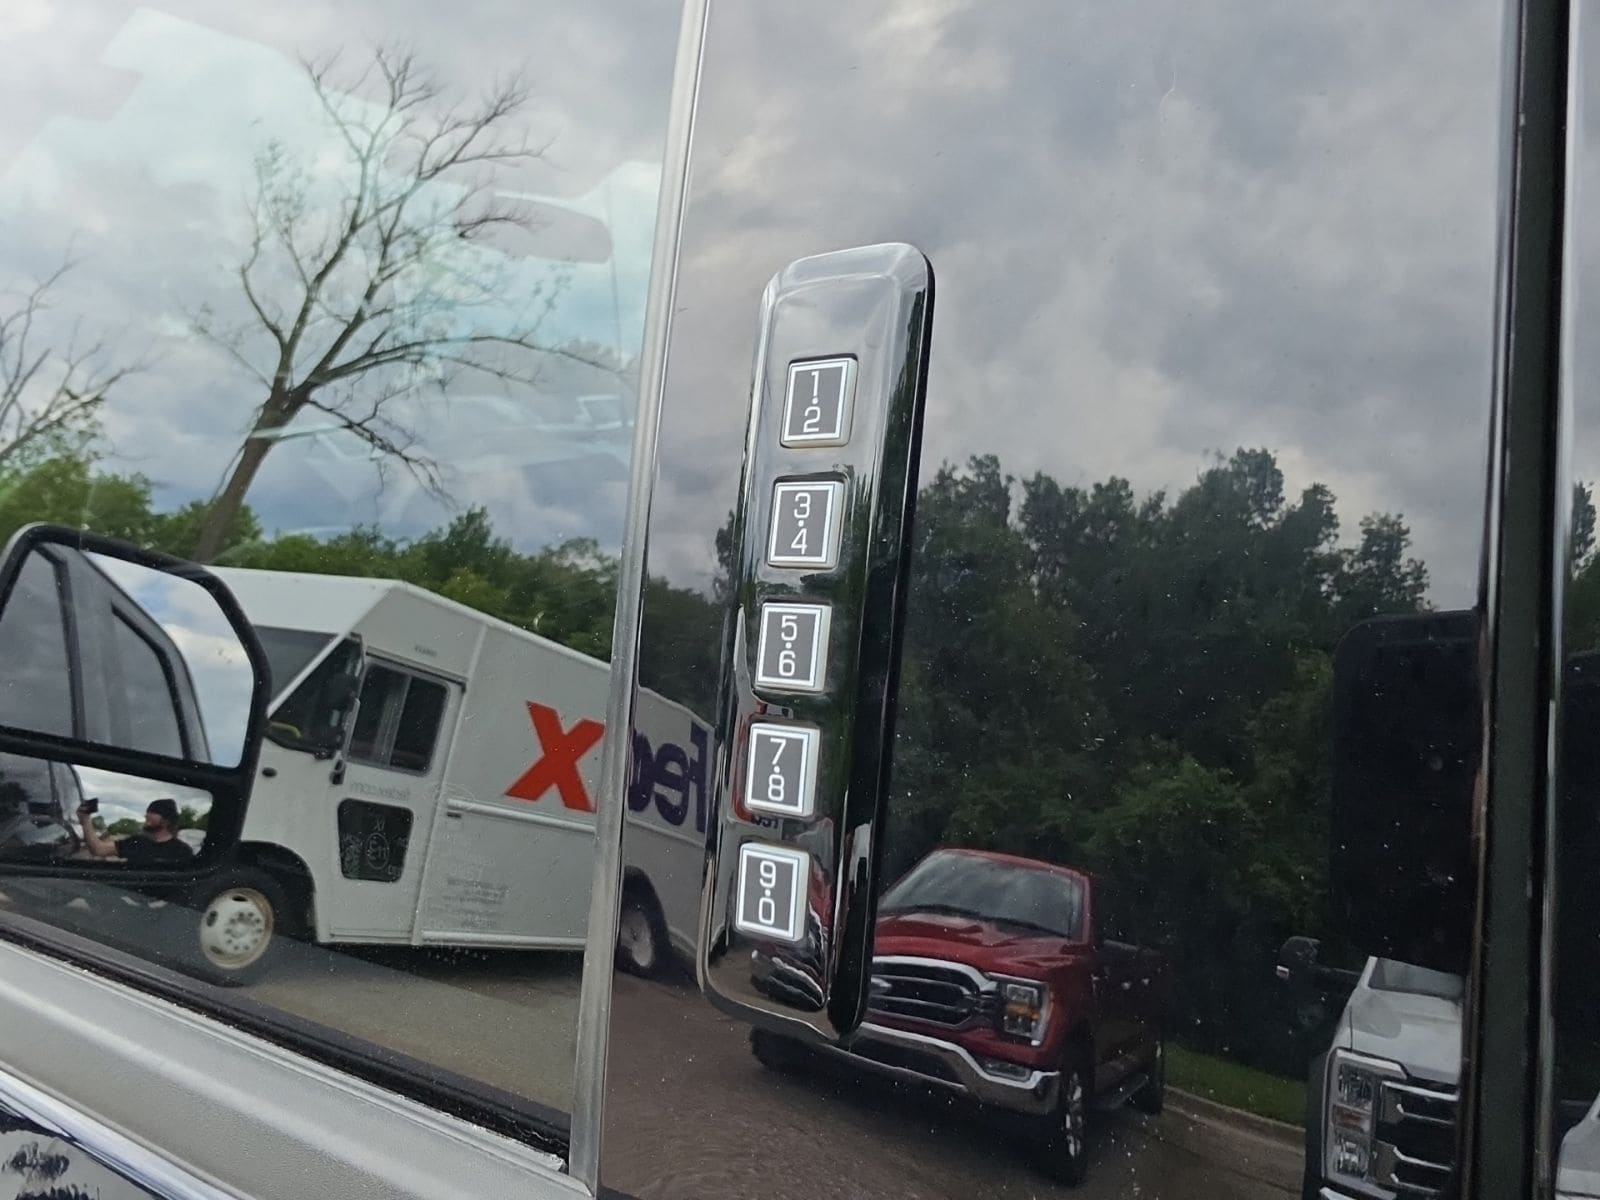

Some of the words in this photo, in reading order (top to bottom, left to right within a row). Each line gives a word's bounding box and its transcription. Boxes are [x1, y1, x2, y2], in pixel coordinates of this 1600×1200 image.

[811, 371, 819, 397] 1
[803, 406, 821, 432] 2
[794, 492, 811, 518] 3
[791, 528, 807, 554] 4
[781, 615, 797, 641] 5
[779, 650, 795, 676] 6
[770, 738, 786, 765] 7
[768, 774, 784, 801] 8
[760, 860, 776, 888] 9
[759, 897, 775, 925] 0
